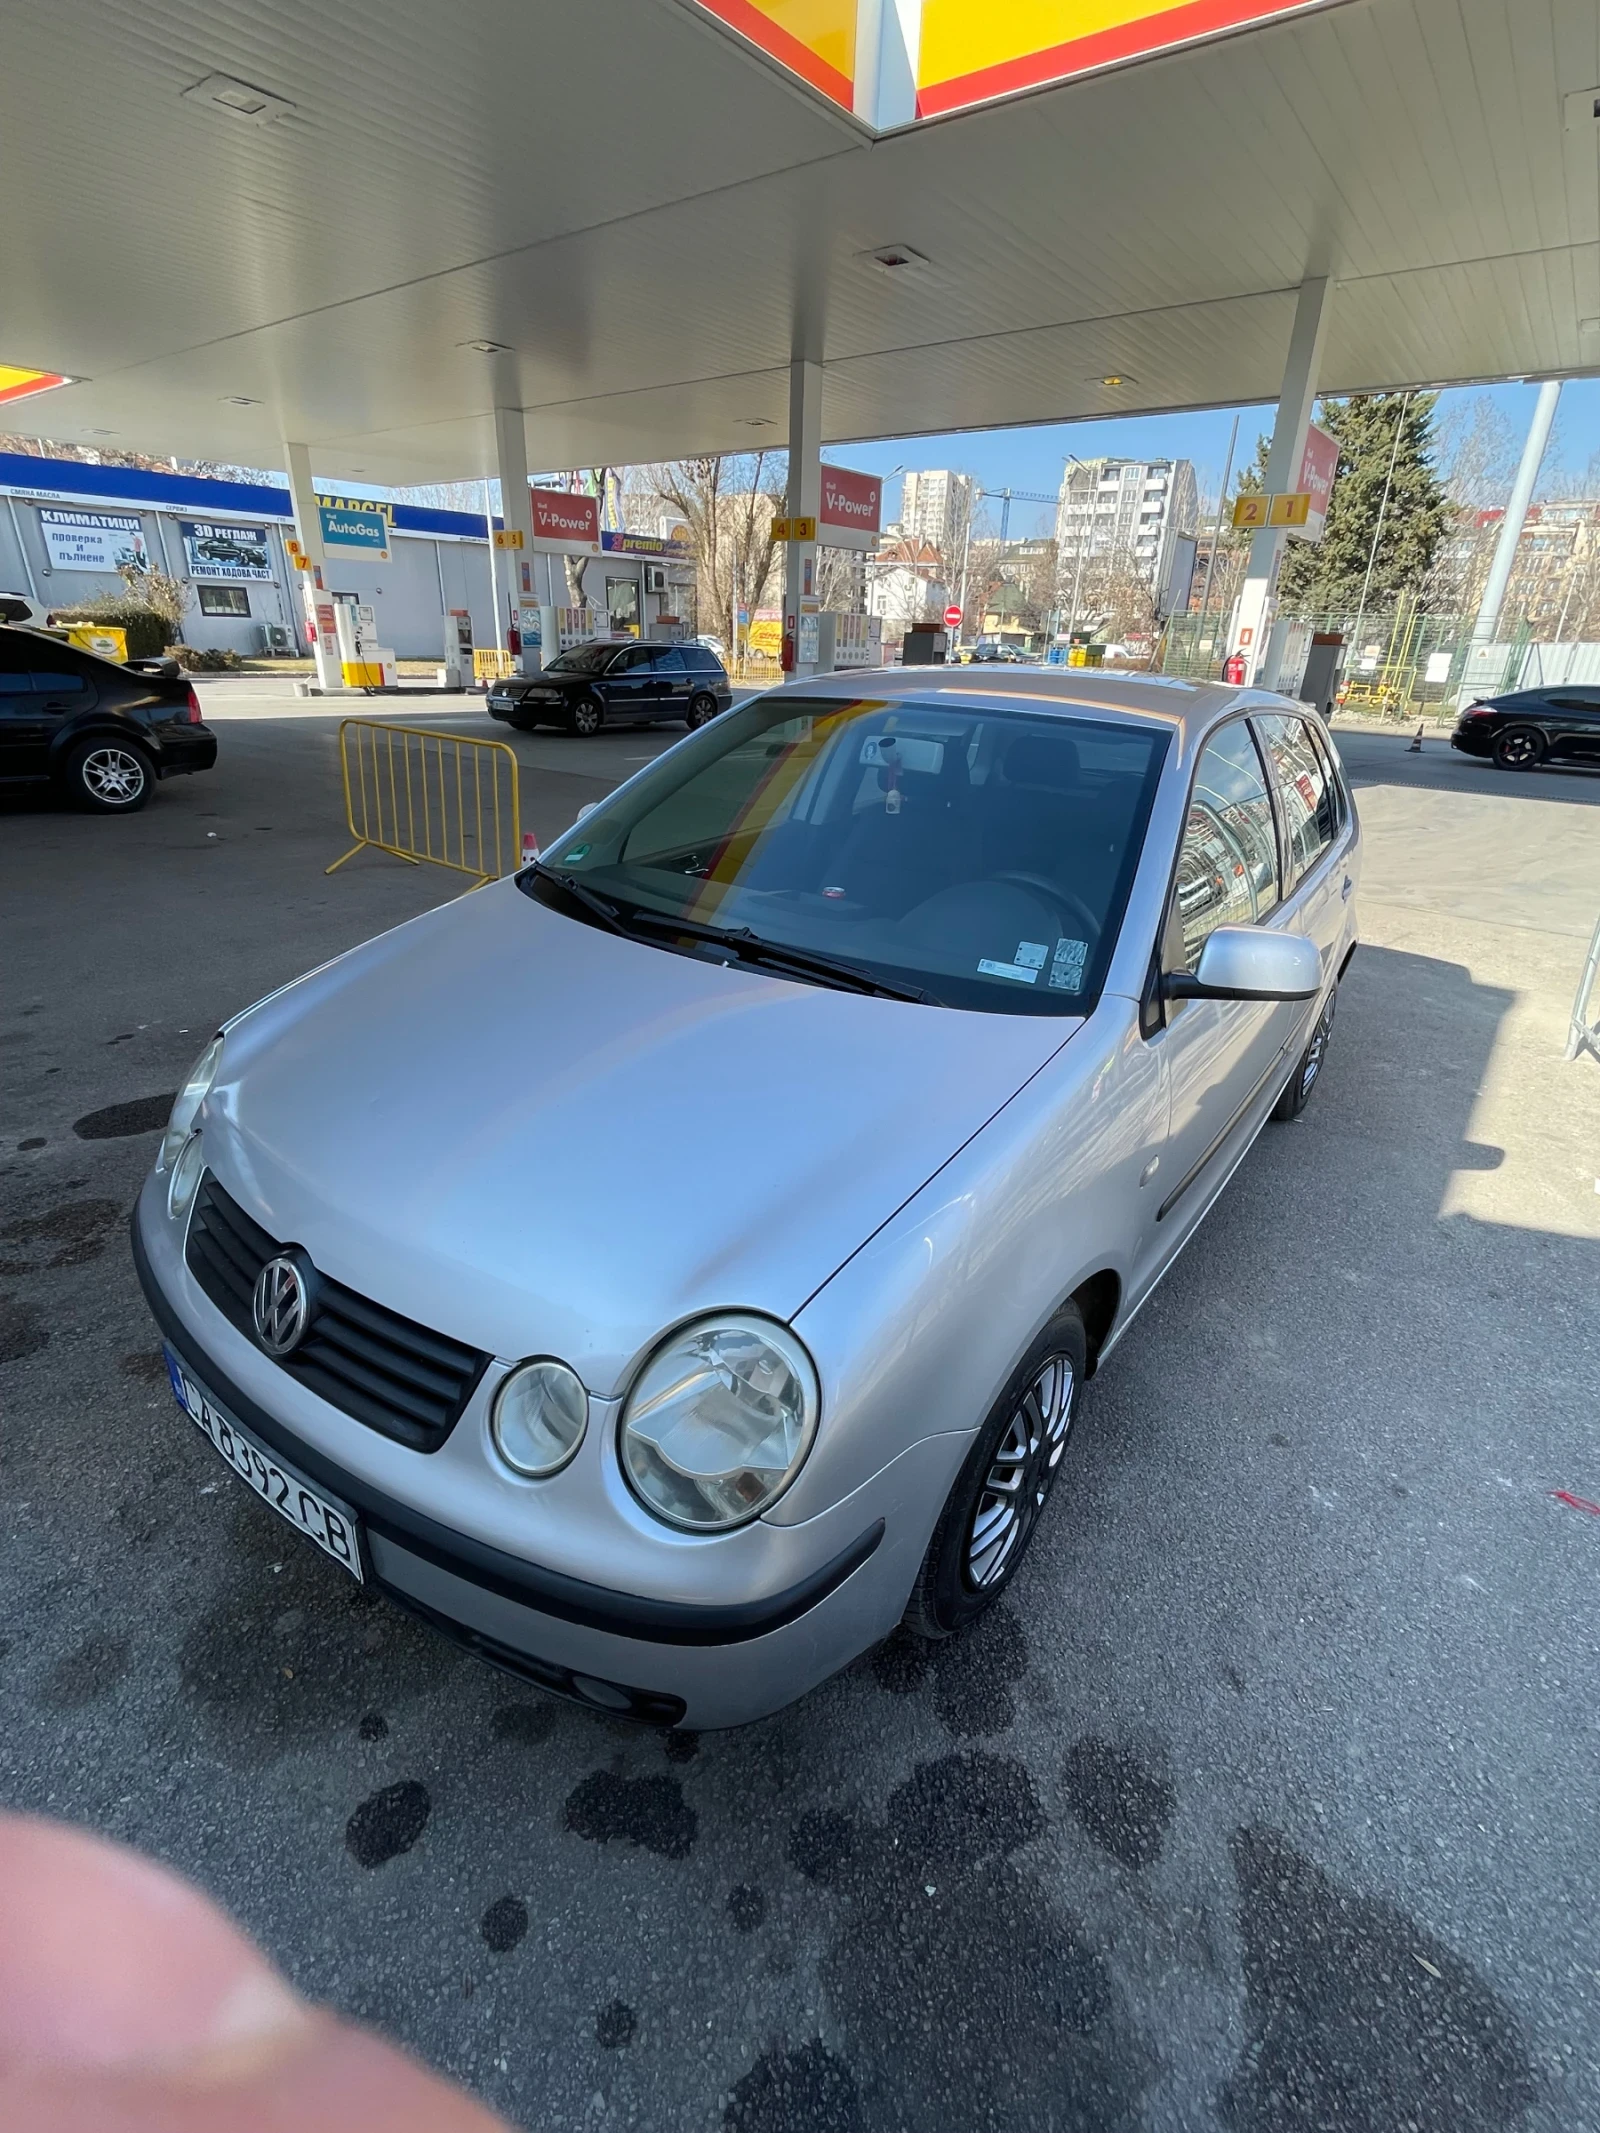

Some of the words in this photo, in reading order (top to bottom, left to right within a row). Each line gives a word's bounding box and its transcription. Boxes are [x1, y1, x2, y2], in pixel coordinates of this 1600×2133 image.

[1303, 461, 1329, 495] V-Power
[826, 491, 874, 517] V-Power
[1286, 500, 1294, 518] 1
[1243, 503, 1258, 521] 2
[40, 509, 141, 531] КЛИМАТИЦИ
[538, 511, 591, 531] V-Power
[194, 524, 214, 538] 3D
[215, 528, 257, 541] РЕГЛАЖ
[327, 520, 380, 538] AutoGas
[776, 523, 786, 535] 4
[799, 522, 807, 536] 3
[51, 532, 103, 544] проверка
[496, 534, 504, 545] 6
[511, 534, 517, 545] 5
[622, 538, 664, 552] premio
[291, 542, 299, 553] 8
[59, 552, 105, 563] пълнене
[299, 557, 308, 569] 7
[190, 565, 221, 577] РЕМОНТ
[222, 567, 251, 579] ХОДОВА
[252, 569, 271, 580] ЧАСТ
